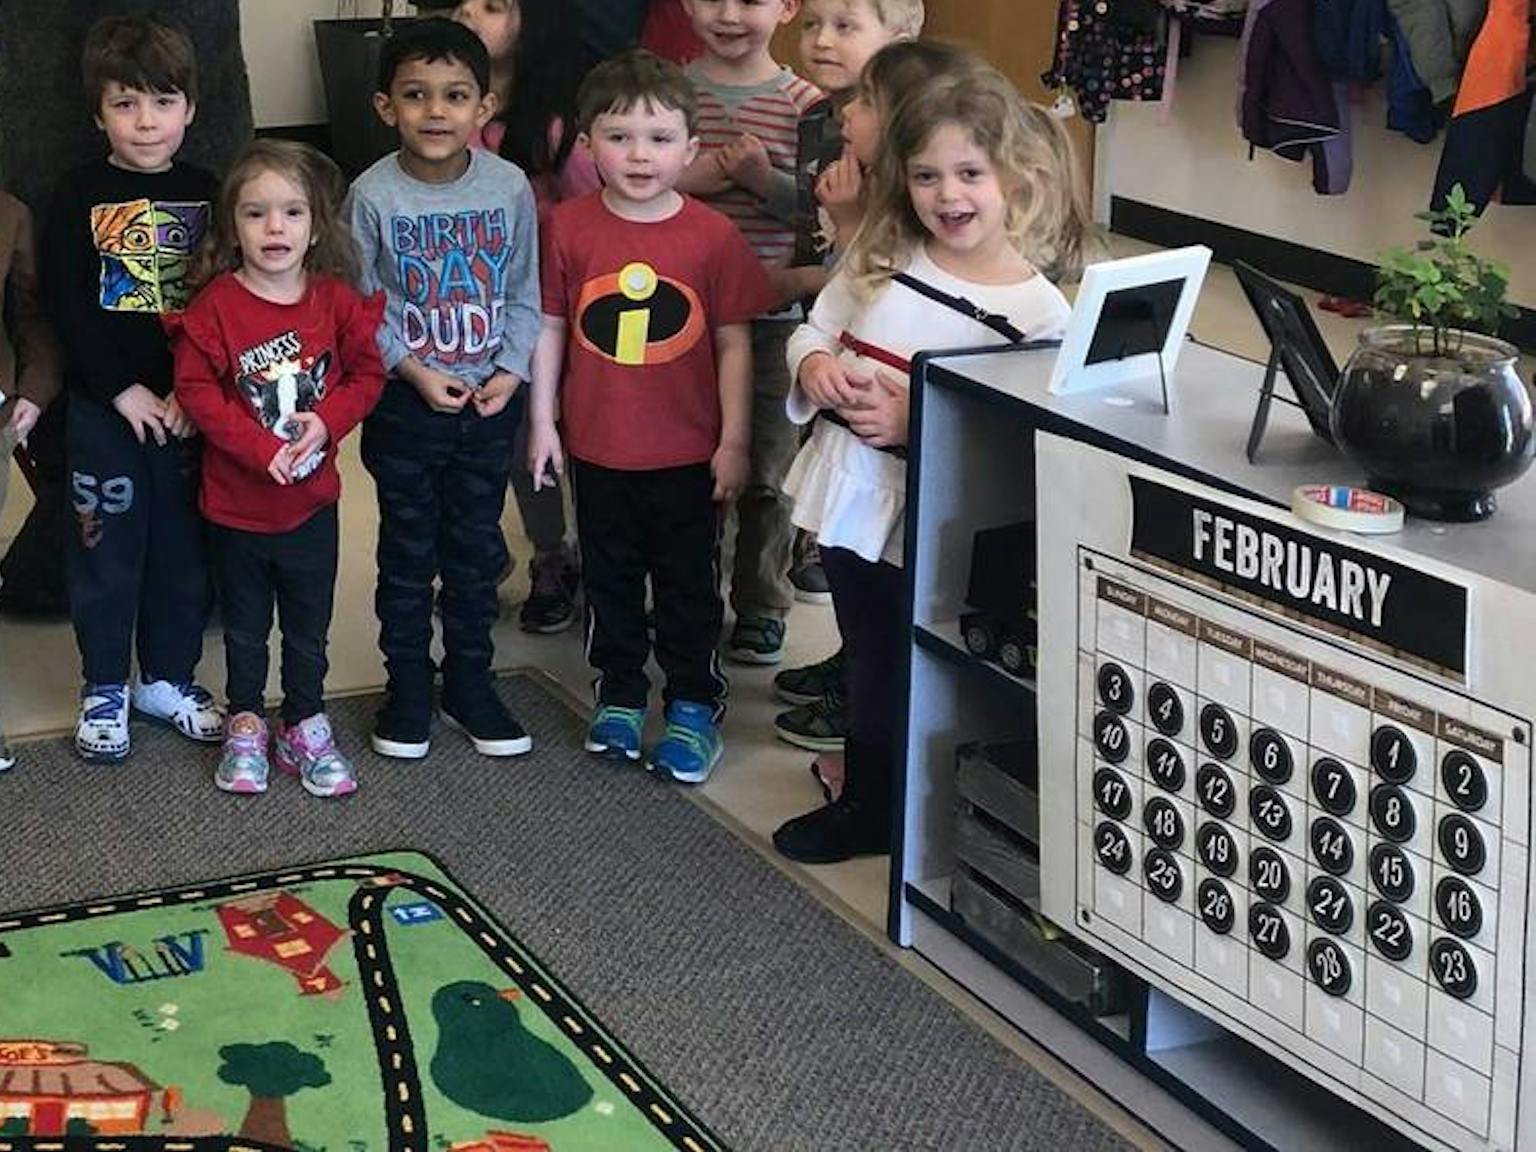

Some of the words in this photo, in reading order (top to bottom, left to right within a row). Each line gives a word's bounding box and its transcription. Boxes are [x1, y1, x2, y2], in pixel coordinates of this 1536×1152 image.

[392, 208, 508, 253] BIRTH
[399, 246, 513, 304] DAY
[238, 329, 302, 375] PRINCESS
[72, 471, 134, 514] 59
[1192, 508, 1392, 627] FEBRUARY
[1108, 675, 1122, 700] 3
[1158, 698, 1173, 720] 4
[1211, 718, 1224, 743] 5
[1263, 742, 1279, 769] 6
[1327, 772, 1342, 799] 7
[1385, 797, 1400, 827] 8
[1454, 827, 1469, 858] 9
[1388, 740, 1400, 768] 1
[1456, 765, 1472, 795] 2
[1101, 723, 1124, 749] 10
[1156, 752, 1177, 777] 11
[1204, 776, 1228, 805] 12
[1258, 799, 1284, 828] 13
[1319, 830, 1345, 861] 14
[1379, 856, 1403, 887] 15
[1446, 891, 1471, 922] 16
[1100, 832, 1125, 862] 24
[1149, 858, 1177, 890] 25
[1204, 890, 1228, 920] 26
[1256, 916, 1280, 943] 27
[1315, 947, 1342, 986] 28
[1101, 780, 1124, 806] 17
[1153, 809, 1175, 837] 18
[1206, 835, 1229, 862] 19
[1256, 861, 1282, 889] 20
[1314, 888, 1345, 920] 21
[1373, 913, 1405, 946] 22
[1440, 950, 1465, 984] 23
